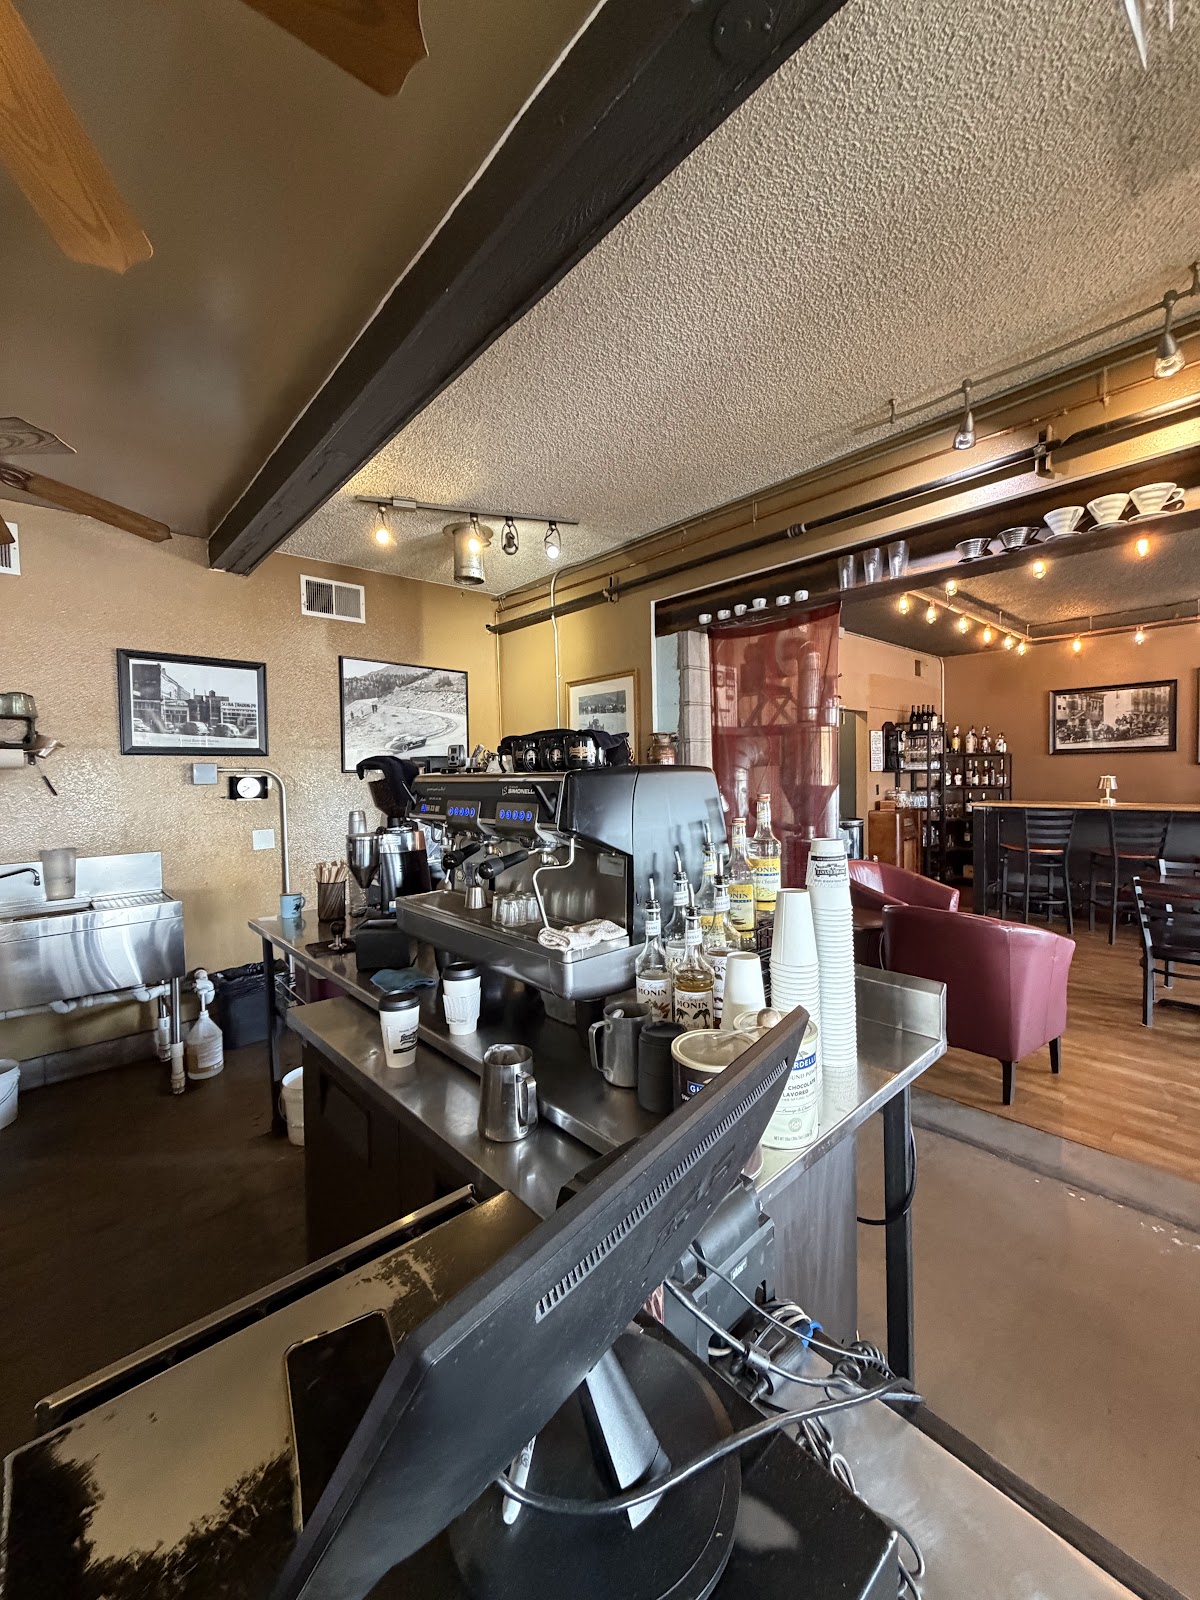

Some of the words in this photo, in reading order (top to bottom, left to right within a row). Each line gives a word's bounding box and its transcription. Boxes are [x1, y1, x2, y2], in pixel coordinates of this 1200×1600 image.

[637, 987, 668, 997] MONIN
[676, 998, 709, 1009] MONIN
[782, 1089, 809, 1098] LAVORED
